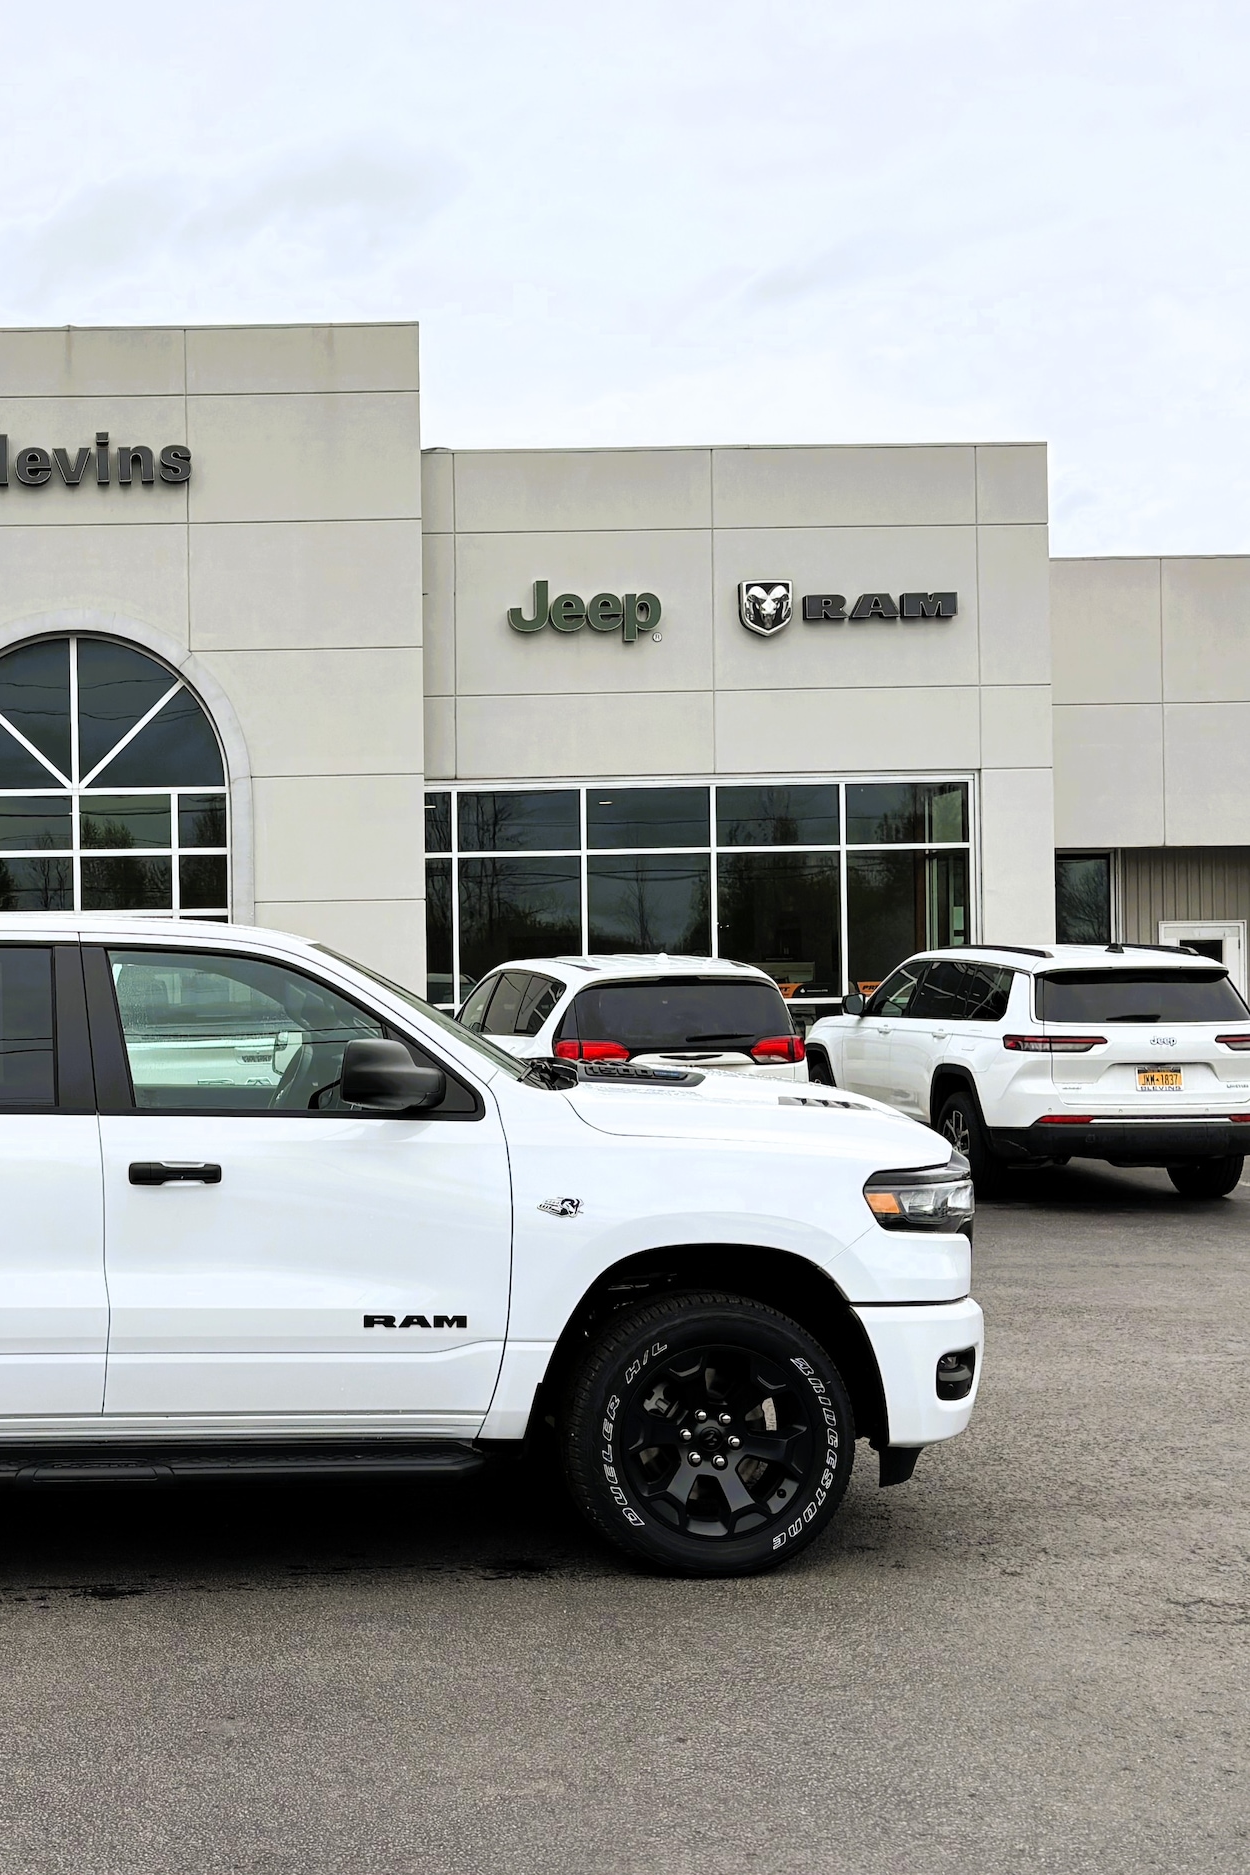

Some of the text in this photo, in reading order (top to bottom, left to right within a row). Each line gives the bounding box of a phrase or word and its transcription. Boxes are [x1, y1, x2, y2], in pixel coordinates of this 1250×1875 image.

[507, 580, 662, 642] Jeep
[802, 592, 958, 621] RAM
[1150, 1036, 1177, 1046] Jeep
[363, 1315, 467, 1328] RAM
[602, 1342, 668, 1527] DUELER H/L
[772, 1357, 839, 1550] BRIDGESTONE
